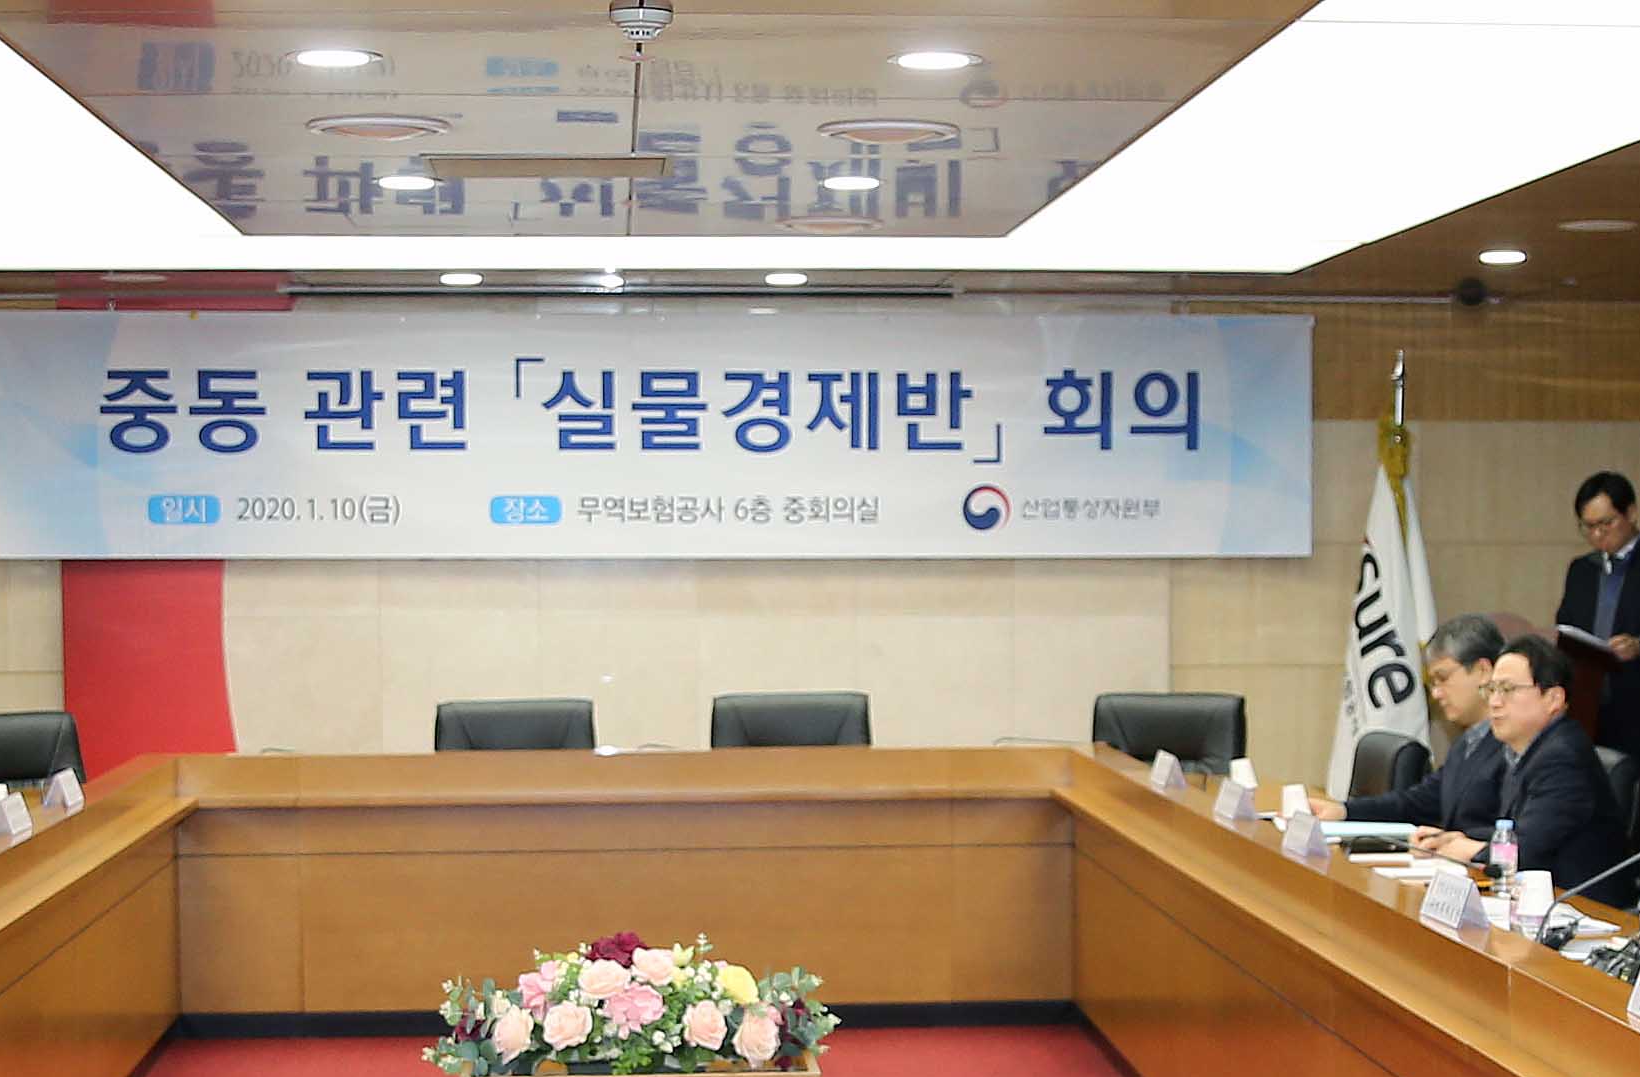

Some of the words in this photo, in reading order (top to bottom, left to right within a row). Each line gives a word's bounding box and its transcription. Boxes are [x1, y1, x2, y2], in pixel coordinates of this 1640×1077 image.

[99, 369, 266, 454] 중동
[304, 369, 468, 452] 관련
[514, 357, 1002, 464] 「실물경제반」
[1043, 369, 1200, 452] 회의
[162, 496, 207, 523] 일시
[504, 496, 550, 522] 장소
[577, 496, 724, 523] 무역보험공사
[735, 496, 772, 523] 6층
[783, 496, 879, 523] 중회의실
[1022, 499, 1160, 520] 산업통상자원부
